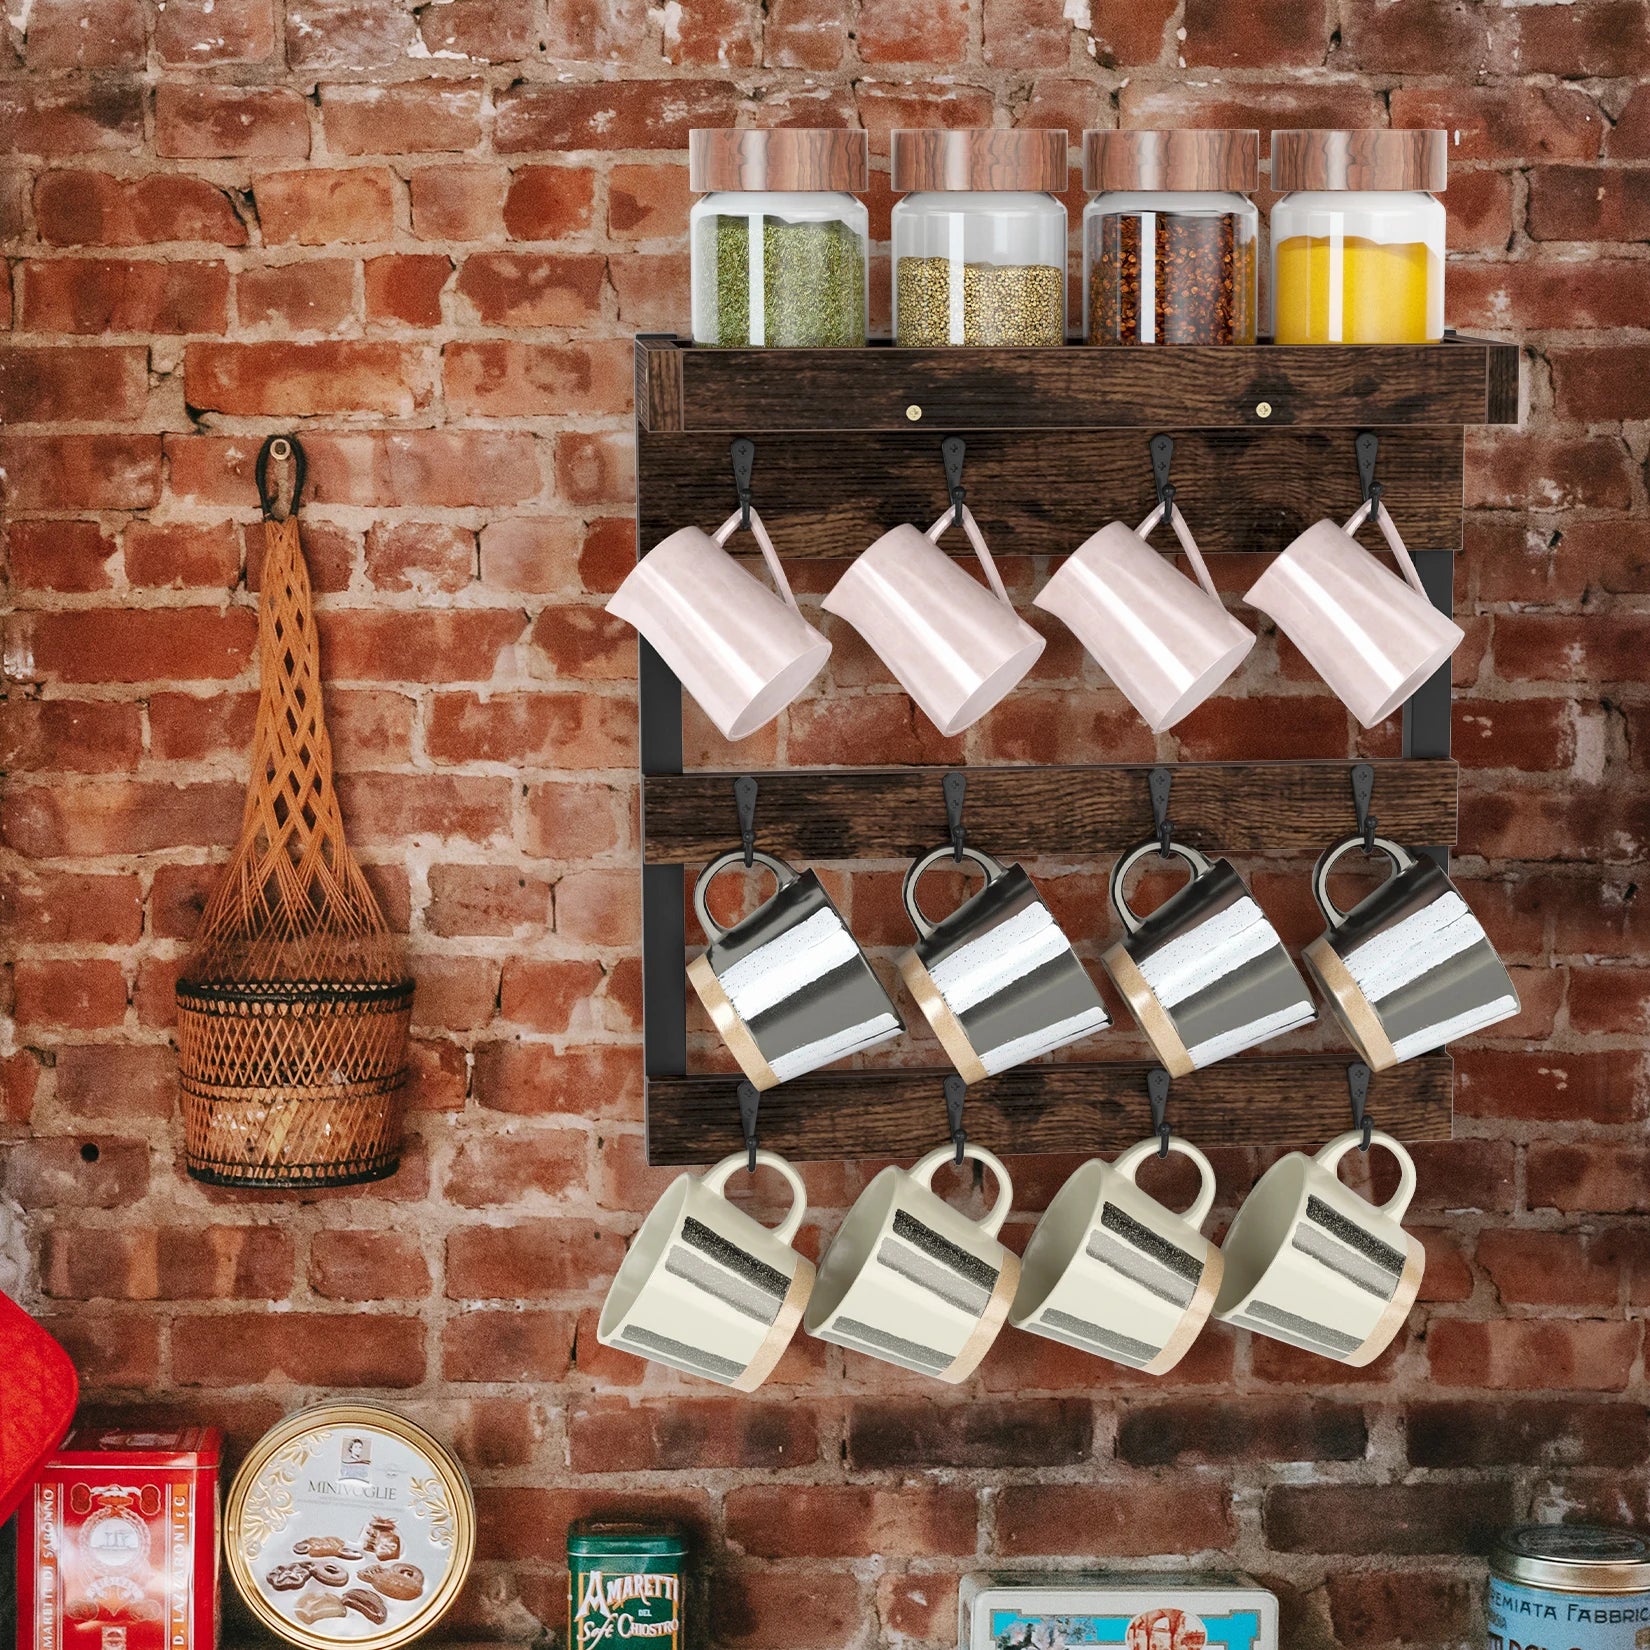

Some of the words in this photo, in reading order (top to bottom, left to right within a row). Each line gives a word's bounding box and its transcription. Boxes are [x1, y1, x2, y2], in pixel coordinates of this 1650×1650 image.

[308, 1480, 397, 1500] MINIVOGLIE
[43, 1488, 54, 1559] SARONNO
[43, 1566, 53, 1580] DI
[173, 1525, 185, 1623] LAZZARONI
[574, 1570, 679, 1621] AMARETTI
[43, 1588, 53, 1650] MARETTI
[577, 1613, 618, 1650] Soft
[617, 1613, 679, 1638] CHIOSTRO
[173, 1630, 184, 1646] D.
